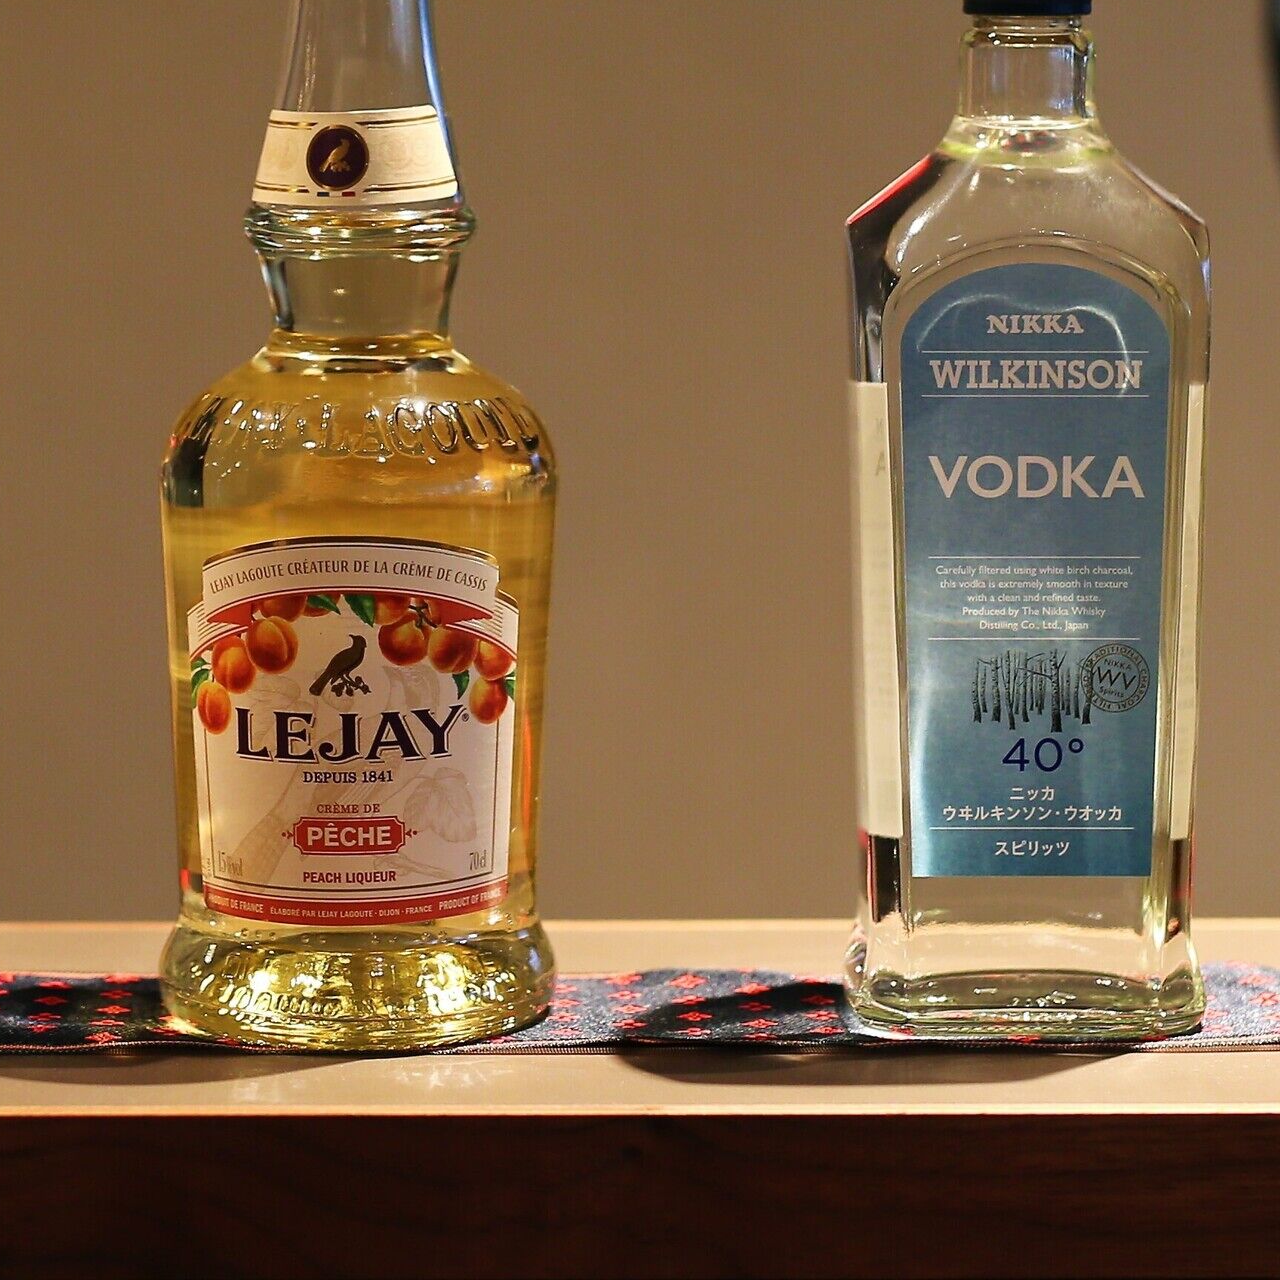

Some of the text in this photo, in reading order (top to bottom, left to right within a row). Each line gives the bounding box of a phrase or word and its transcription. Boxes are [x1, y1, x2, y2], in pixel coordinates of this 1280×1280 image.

[986, 314, 1084, 334] NIKKA
[929, 359, 1143, 390] WILKINSON
[928, 455, 1145, 498] VODKA
[210, 573, 235, 594] LEJAY
[236, 563, 284, 585] LAGOUTE
[353, 560, 370, 573] DE
[374, 561, 388, 574] LA
[436, 567, 451, 582] DE
[454, 571, 488, 592] CASSIS
[936, 565, 976, 576] Carefully
[979, 565, 1011, 574] filtered
[1039, 565, 1064, 574] white
[940, 580, 1128, 590] this vodka is extremely smooth in texture
[967, 593, 987, 602] with
[997, 593, 1020, 602] clean
[1023, 593, 1039, 602] and
[1042, 593, 1073, 602] refined
[962, 607, 1106, 618] Produced by The Nikka Whisky
[980, 621, 1088, 631] Distilling Japan
[1097, 666, 1137, 691] WV
[1001, 737, 1084, 772] 40°
[303, 770, 394, 784] DEPUIS 1841
[1010, 786, 1056, 801] ニッカ
[317, 802, 381, 814] CRÈME DE
[307, 822, 392, 847] PÊCHE
[995, 840, 1070, 856] スピリッツ
[303, 870, 397, 885] PEACH LIQUEUR
[230, 898, 239, 909] DE
[239, 900, 264, 914] FRANCE
[302, 909, 316, 918] PAR
[317, 910, 338, 918] LEJAY
[340, 910, 372, 918] LAGOUTE
[379, 909, 400, 917] DIJON
[405, 904, 433, 915] FRANCE
[438, 896, 470, 911] PRODUCT
[470, 894, 480, 904] OF
[480, 888, 502, 902] FRANCE
